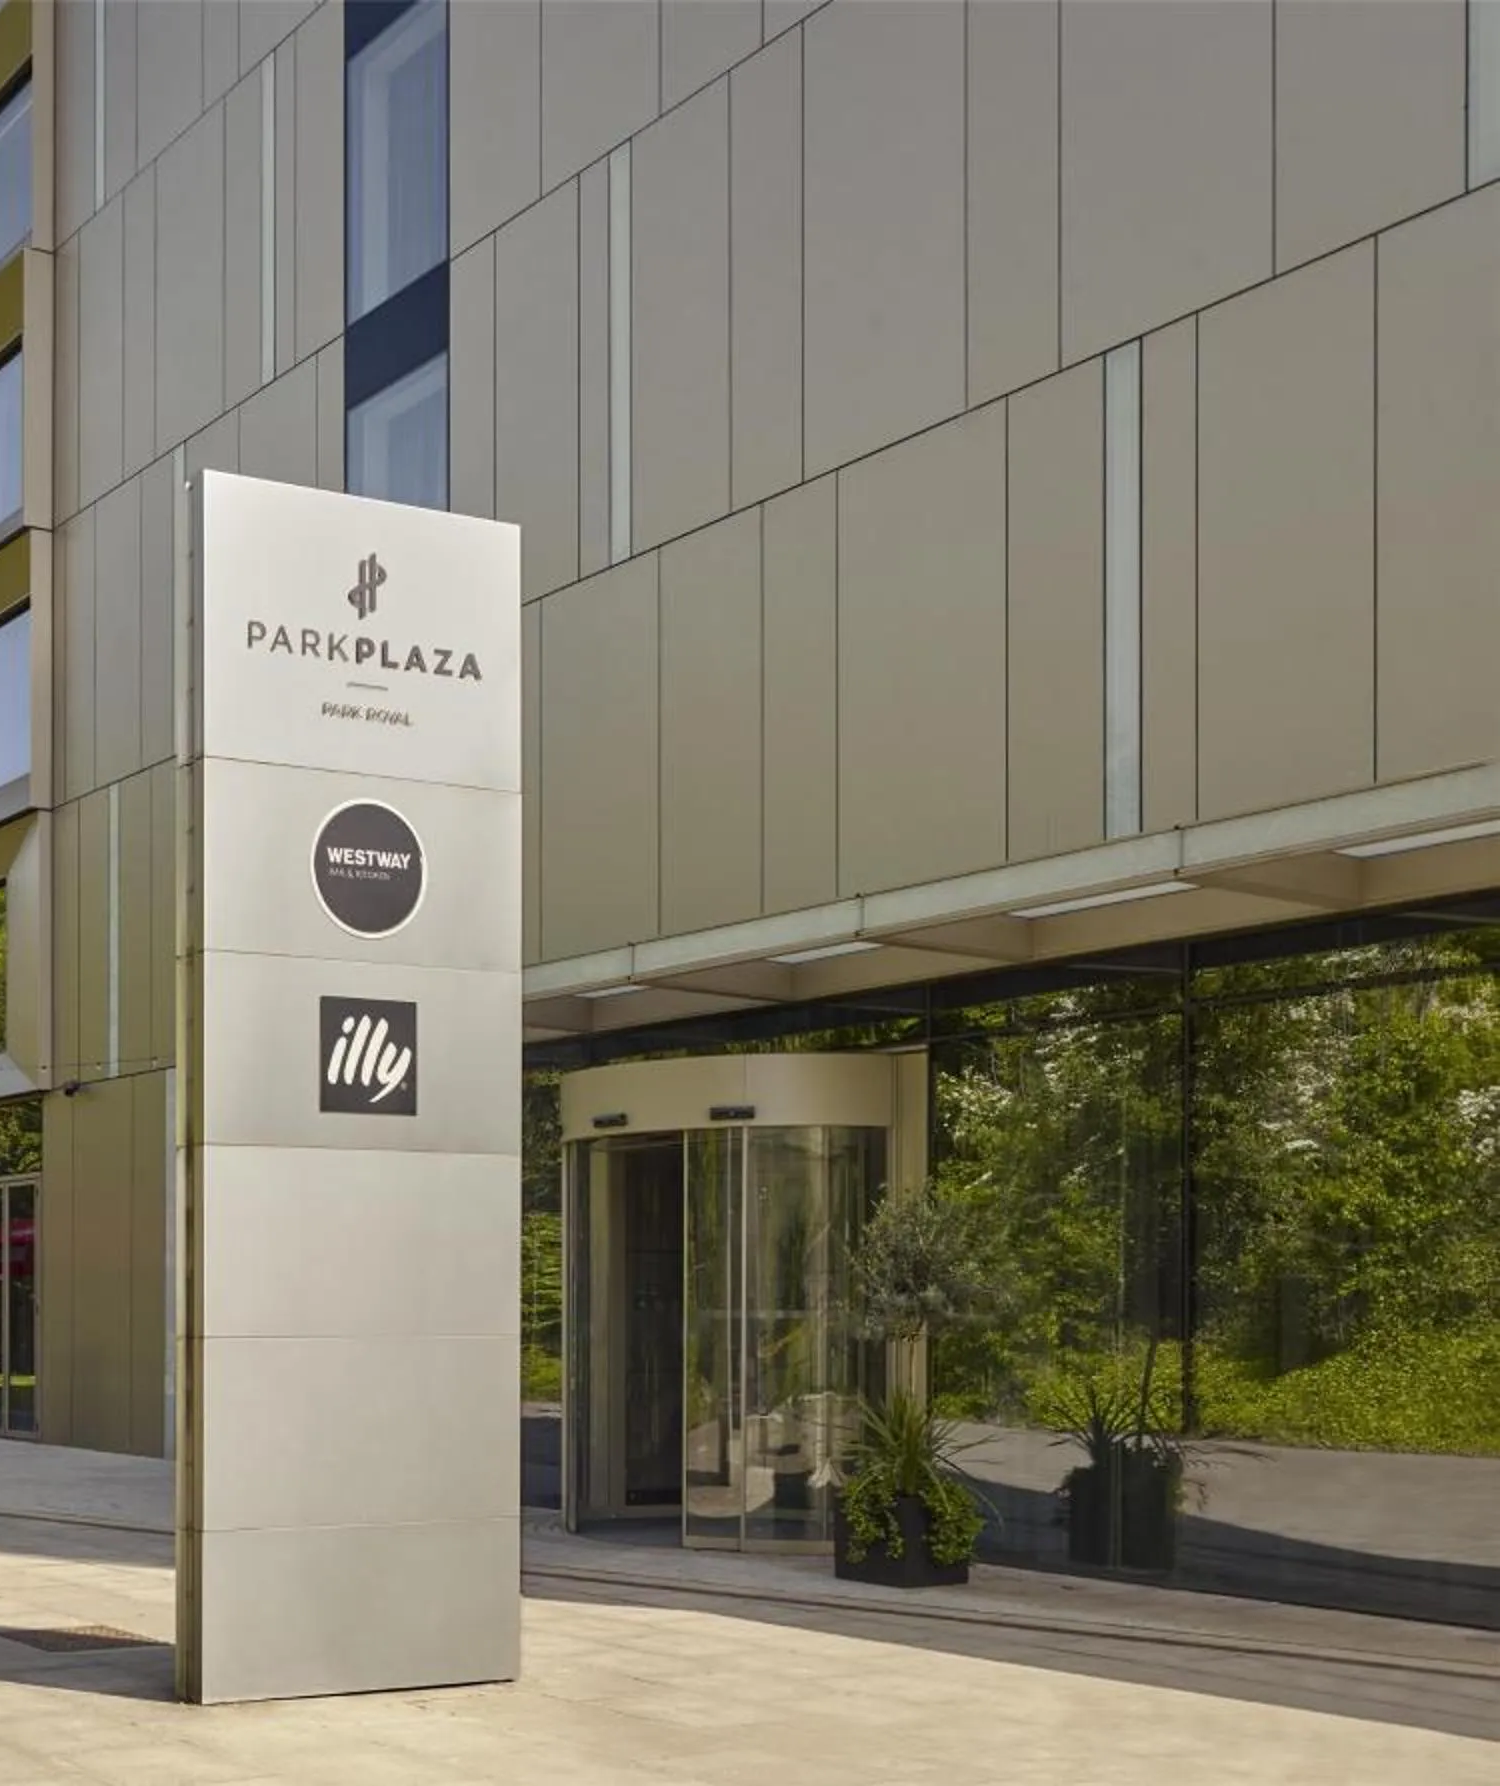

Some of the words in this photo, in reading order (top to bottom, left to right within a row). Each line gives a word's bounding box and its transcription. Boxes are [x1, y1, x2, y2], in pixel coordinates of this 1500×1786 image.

[322, 702, 363, 720] PARK
[365, 707, 414, 726] ROYAL
[327, 847, 411, 870] WESTWAY
[328, 1014, 412, 1103] illy
